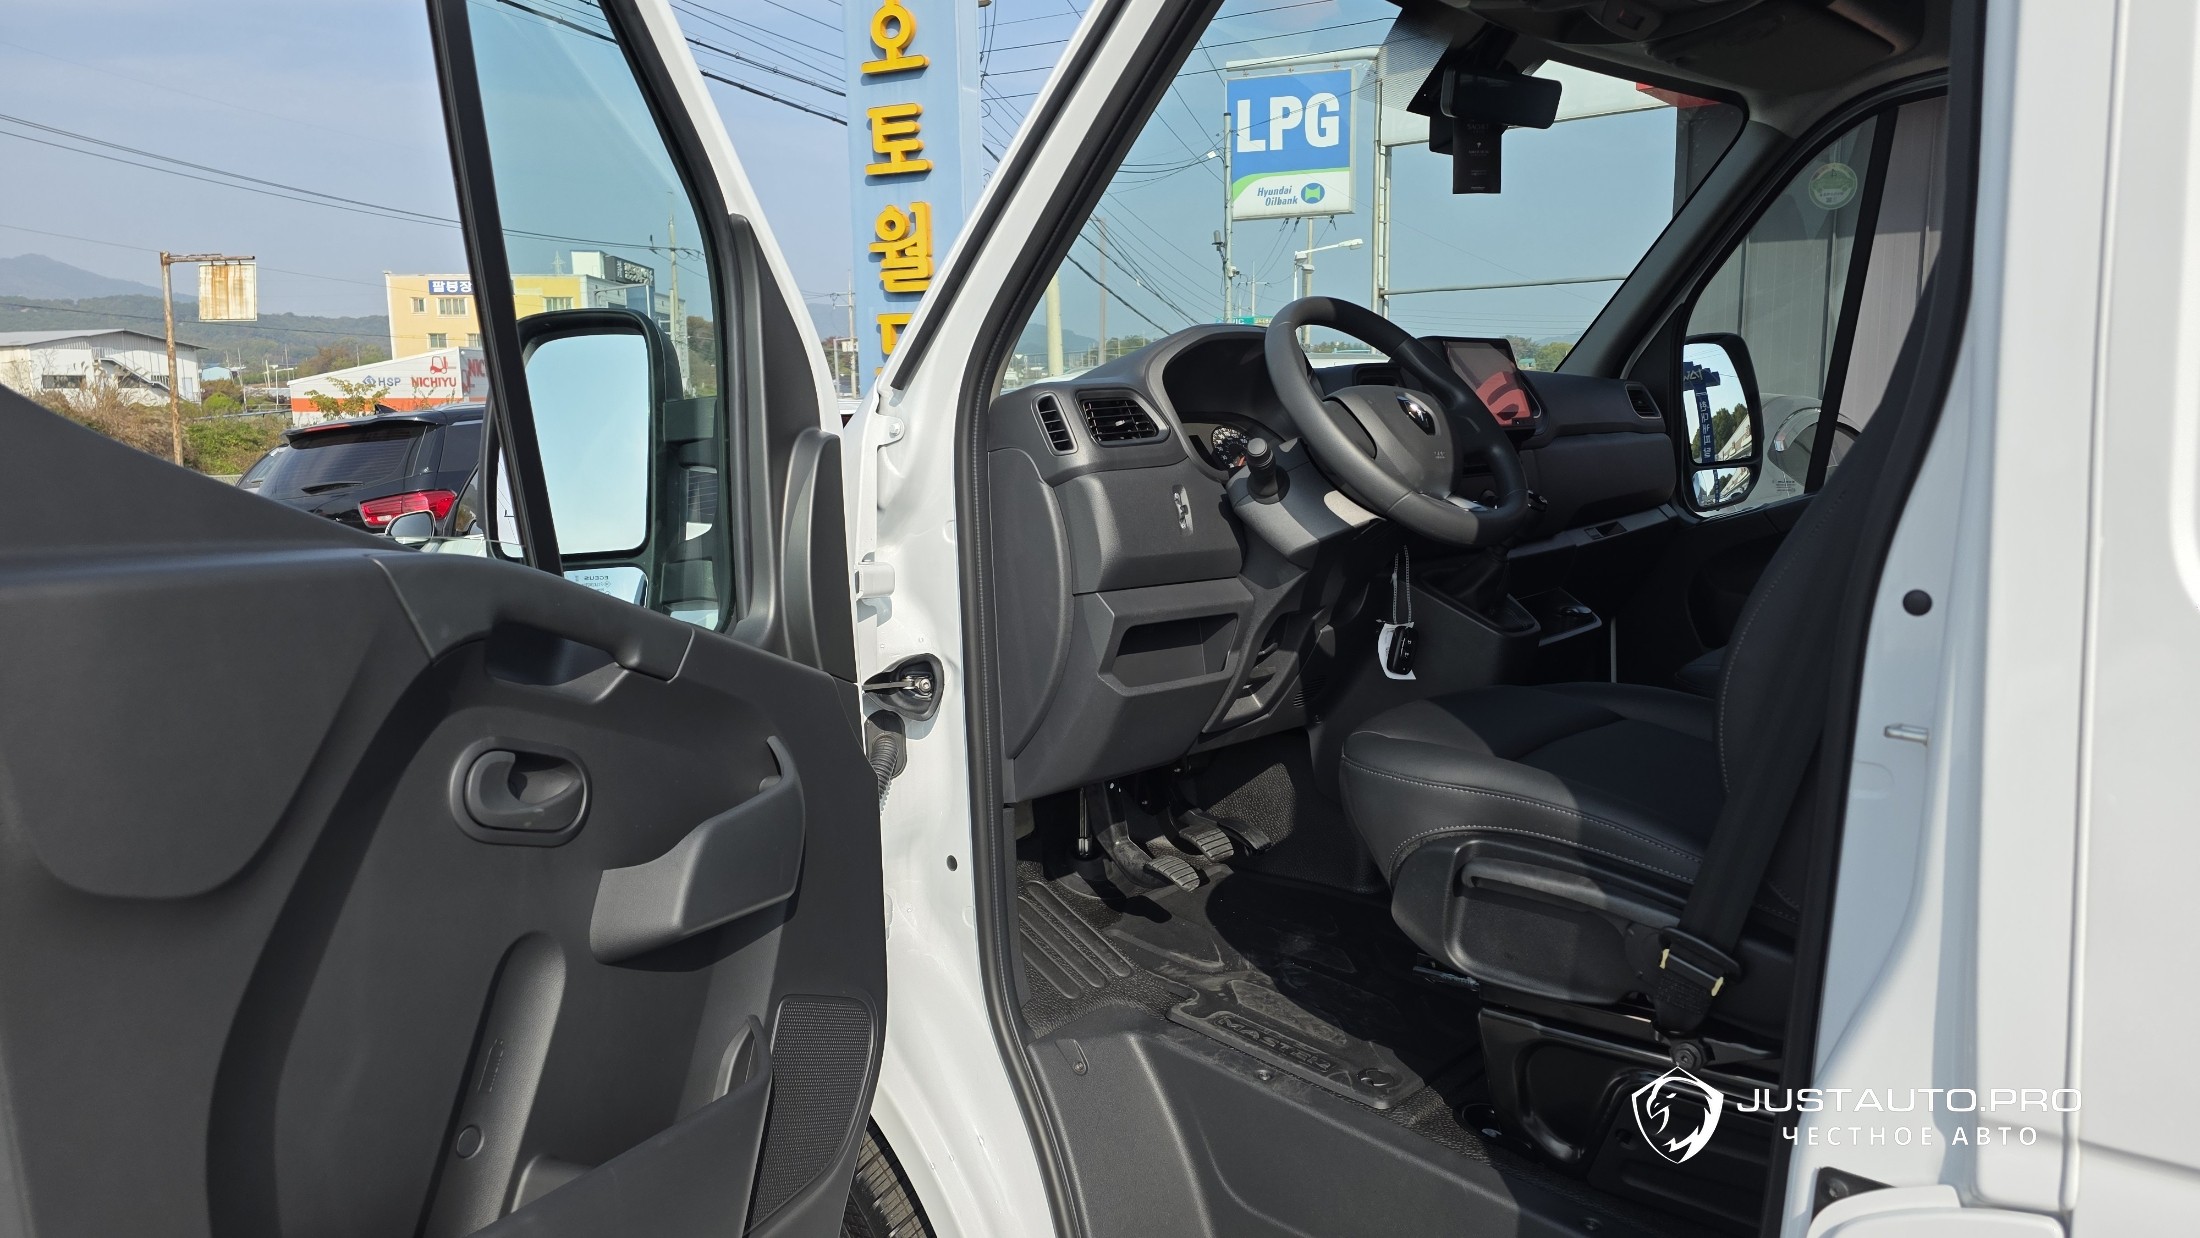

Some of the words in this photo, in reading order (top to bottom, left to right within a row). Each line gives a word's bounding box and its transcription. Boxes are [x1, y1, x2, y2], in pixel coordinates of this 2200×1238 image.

[1236, 92, 1340, 153] LPG
[1257, 185, 1293, 198] Hyundai
[1265, 195, 1298, 207] Oilbank
[378, 376, 401, 387] HSP
[410, 376, 457, 388] NICHIYU
